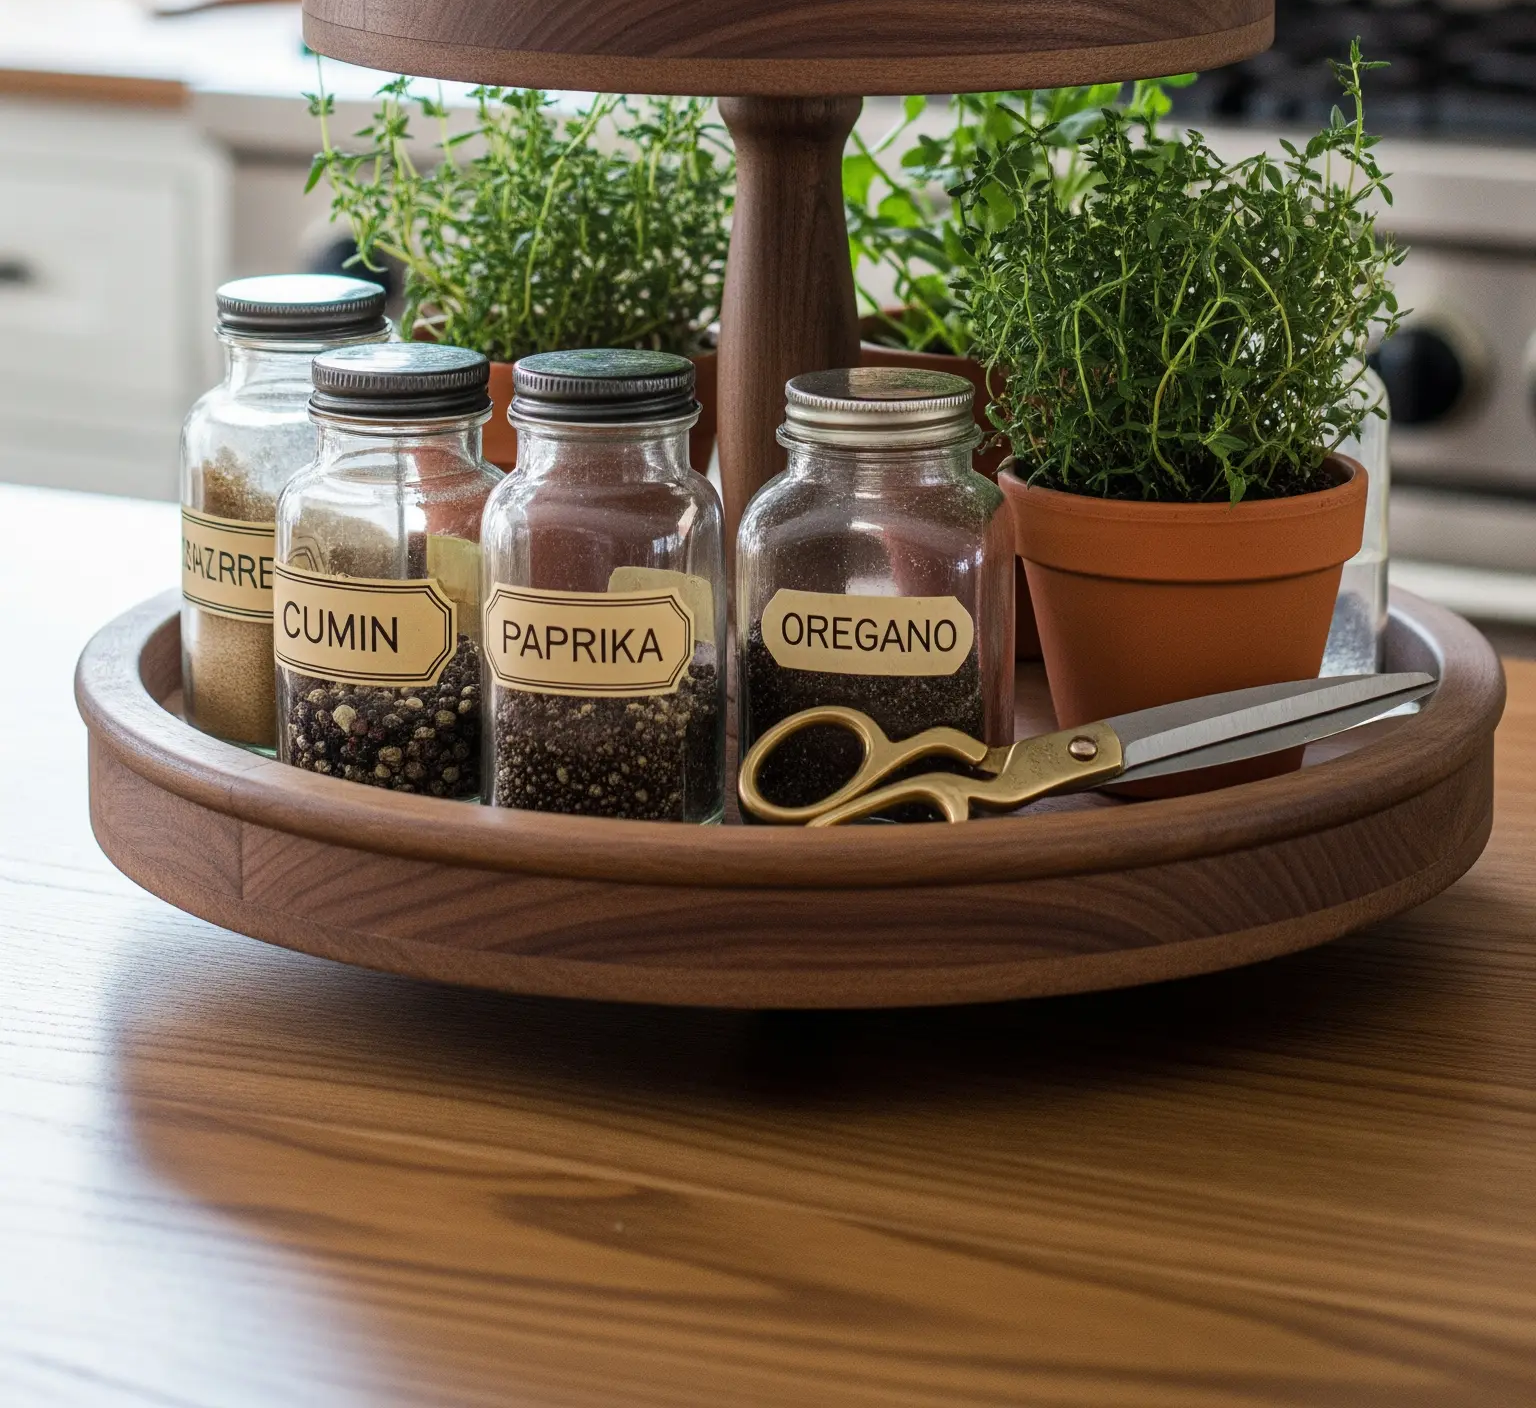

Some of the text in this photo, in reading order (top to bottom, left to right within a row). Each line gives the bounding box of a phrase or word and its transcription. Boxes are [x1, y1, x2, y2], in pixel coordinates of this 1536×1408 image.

[283, 601, 398, 653] CUMIN
[503, 619, 664, 664] PAPRIKA
[781, 612, 957, 653] OREGANO
